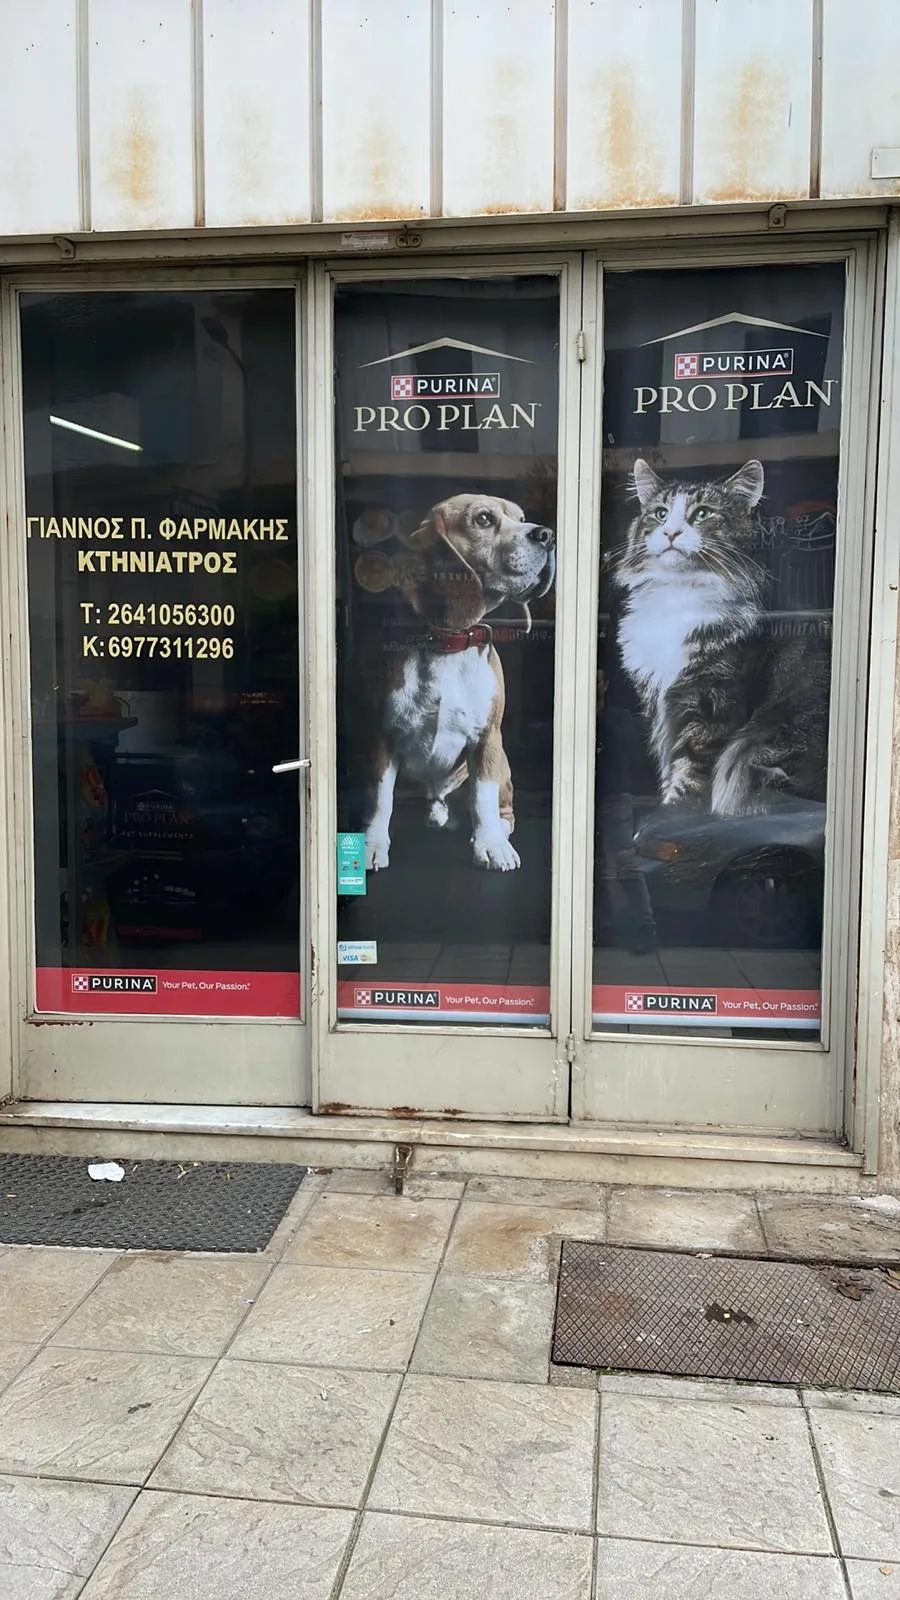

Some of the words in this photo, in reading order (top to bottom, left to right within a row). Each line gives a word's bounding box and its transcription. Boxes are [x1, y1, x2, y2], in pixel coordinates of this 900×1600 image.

[633, 384, 717, 414] PRO
[724, 379, 836, 410] PLAN
[353, 404, 431, 432] PRO
[437, 403, 539, 430] PLAN
[26, 517, 123, 539] ΓΙΑΝΝΟΣ
[131, 517, 152, 539] Π.
[159, 517, 289, 540] ΦΑΡΜΑΚΗΣ
[78, 550, 237, 573] ΚΤΗΝΙΑΤΡΟΣ
[108, 603, 235, 626] 2641056300
[162, 981, 181, 990] Your
[199, 982, 214, 990] Our
[445, 995, 463, 1004] Your
[482, 997, 498, 1006] Our
[722, 1000, 741, 1010] Your
[763, 1002, 778, 1011] Our
